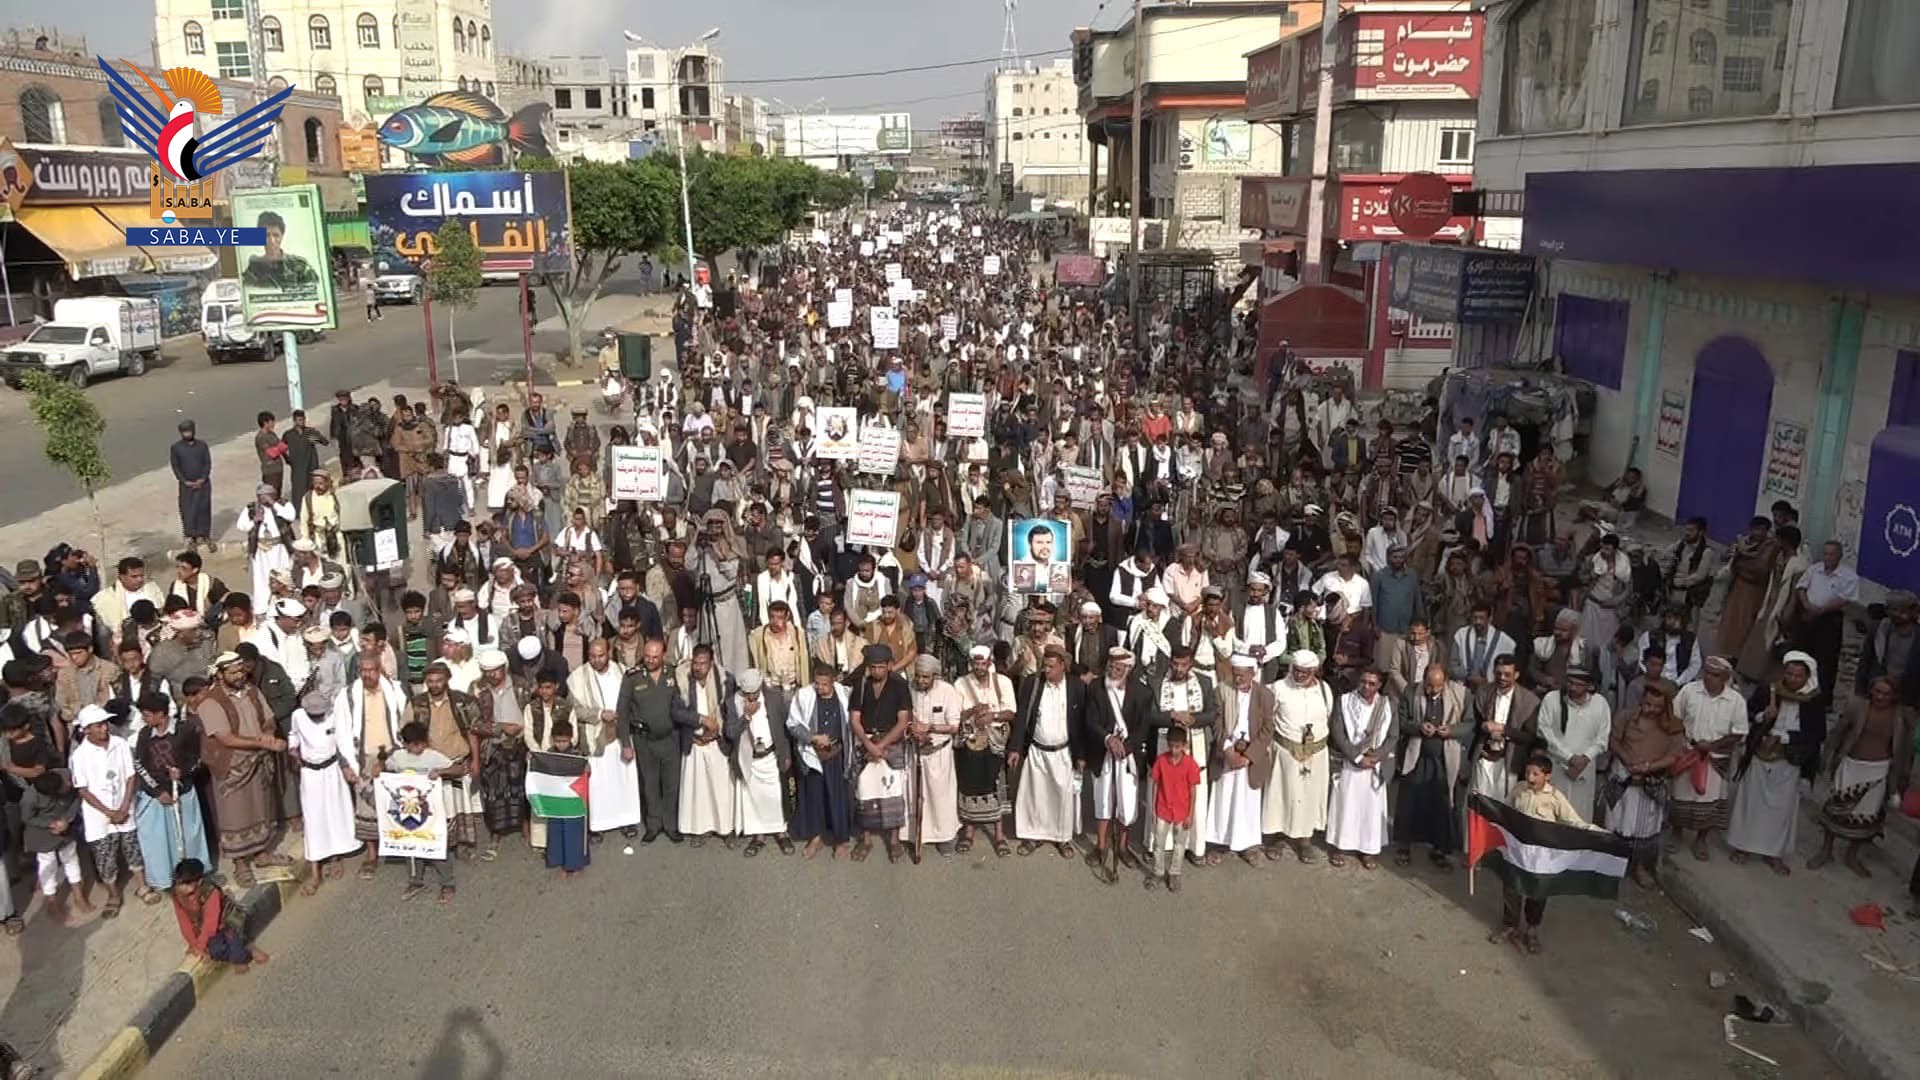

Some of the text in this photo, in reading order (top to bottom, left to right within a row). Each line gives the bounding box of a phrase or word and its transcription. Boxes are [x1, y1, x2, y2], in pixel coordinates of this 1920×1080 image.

[1396, 15, 1473, 45] شبام
[1392, 52, 1470, 78] حضرموت
[34, 157, 123, 199] وبروست
[400, 173, 535, 217] أسماك
[395, 217, 547, 263] القاي
